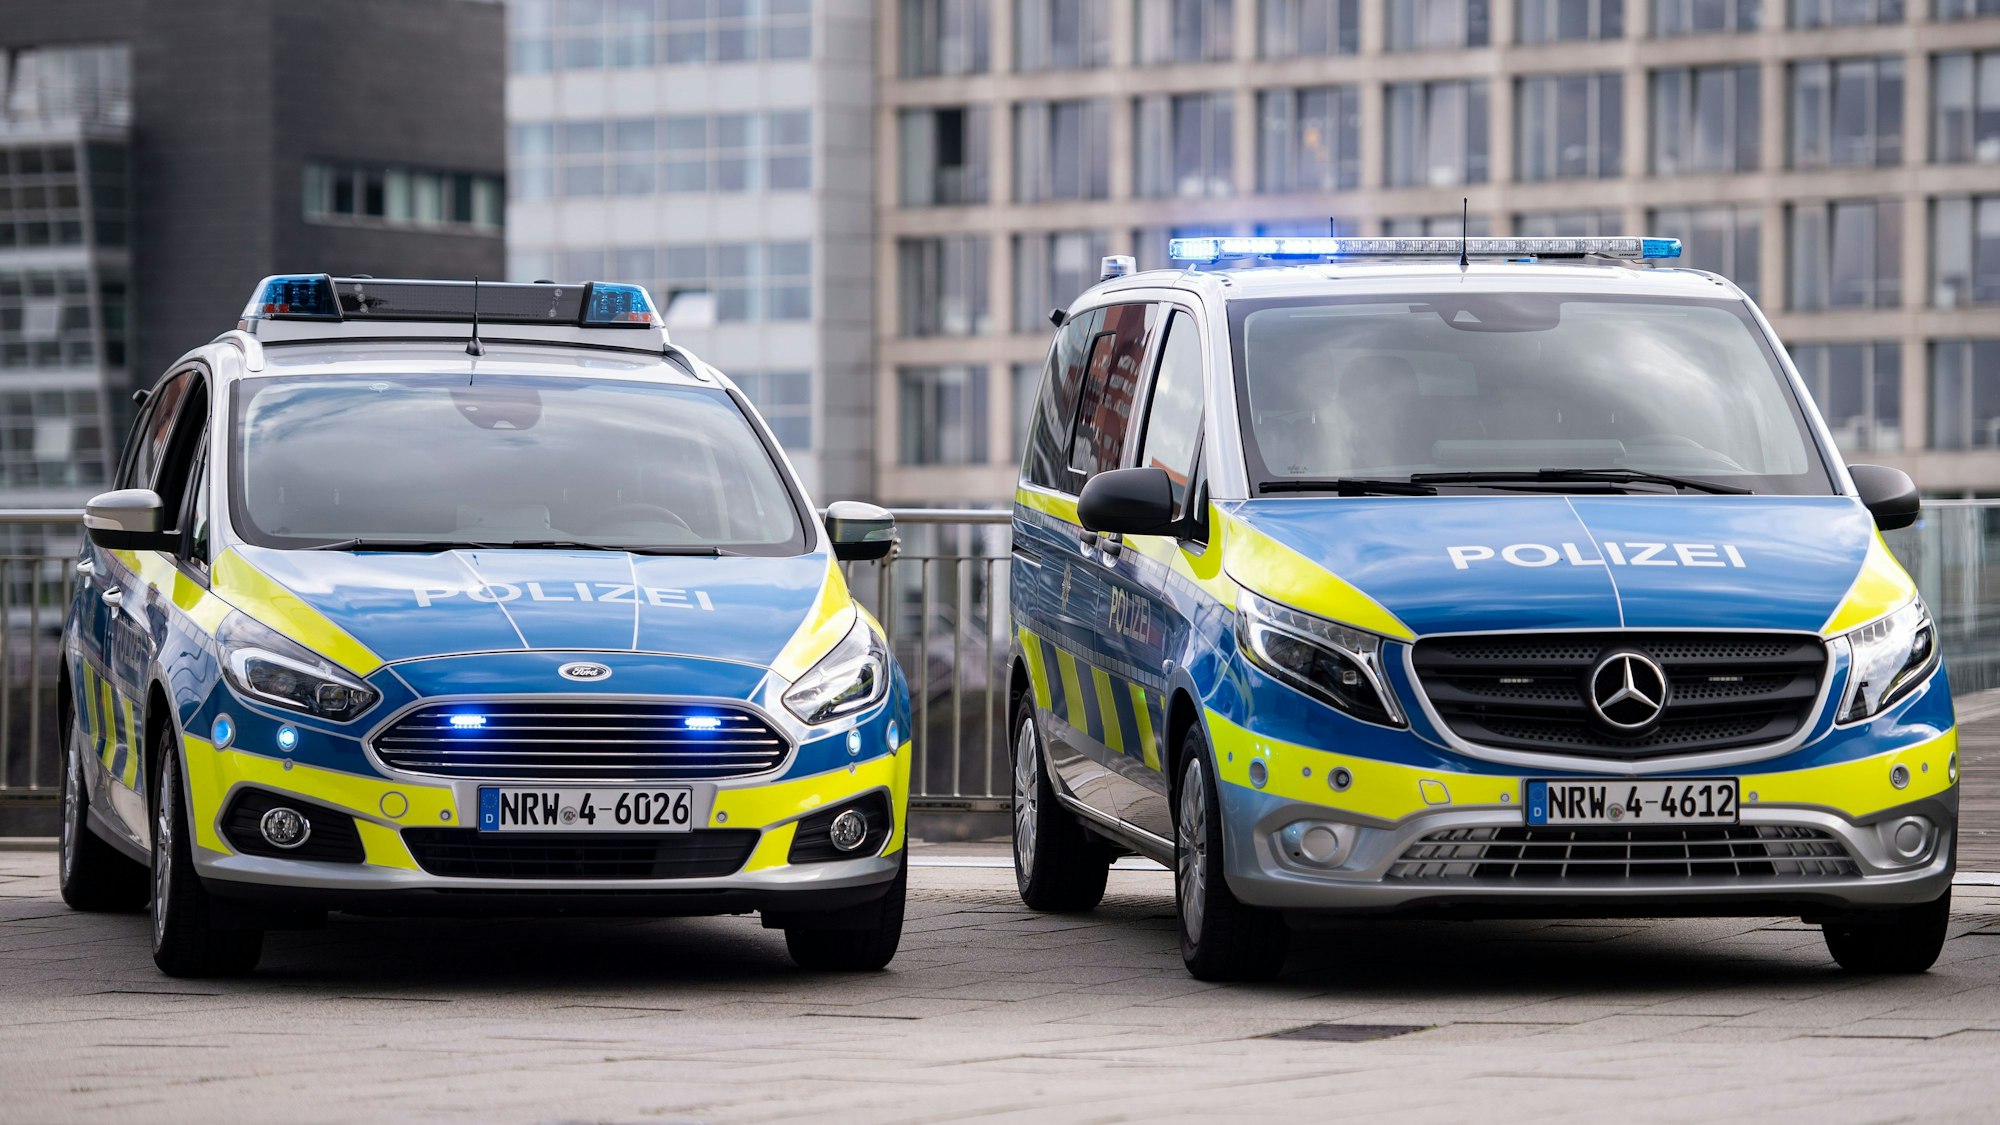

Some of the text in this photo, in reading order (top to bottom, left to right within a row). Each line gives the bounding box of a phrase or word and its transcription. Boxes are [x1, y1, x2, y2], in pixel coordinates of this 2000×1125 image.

[1446, 542, 1746, 570] POLIZEI
[412, 582, 714, 611] POLIZEI
[1108, 585, 1150, 645] POLIZEI
[571, 667, 598, 676] Ford
[501, 793, 689, 825] NRW 4-6026
[1533, 807, 1542, 817] D
[1548, 785, 1734, 818] NRW 4-4612
[485, 813, 494, 824] D
